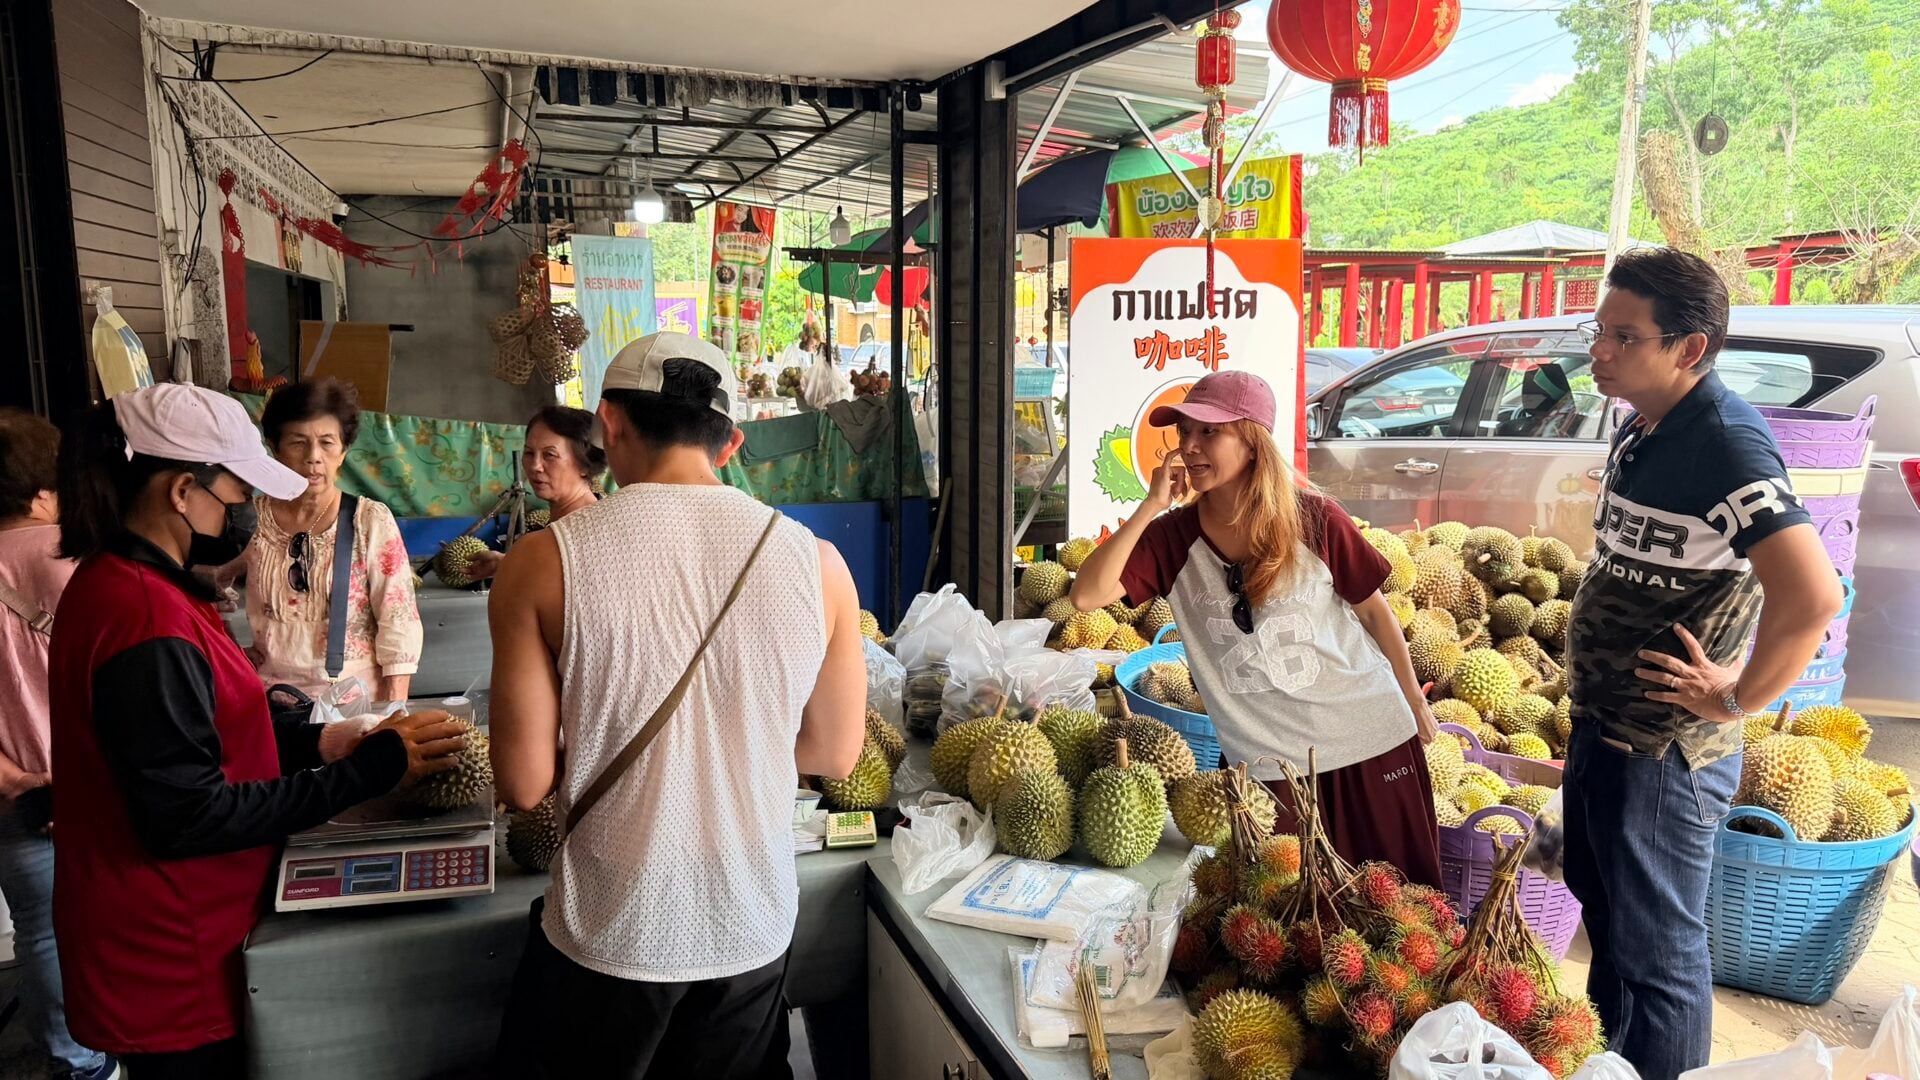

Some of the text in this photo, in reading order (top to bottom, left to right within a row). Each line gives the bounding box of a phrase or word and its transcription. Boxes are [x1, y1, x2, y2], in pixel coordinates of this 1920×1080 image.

[582, 247, 644, 269] ร้านอาหาร
[584, 277, 644, 290] RESTAURANT
[1112, 280, 1257, 321] กาแฟสด
[1134, 325, 1229, 371] 咖啡
[1592, 498, 1689, 559] UPER
[1206, 614, 1320, 694] 26
[1383, 765, 1414, 783] MARDI
[287, 887, 320, 895] SUNFORD
